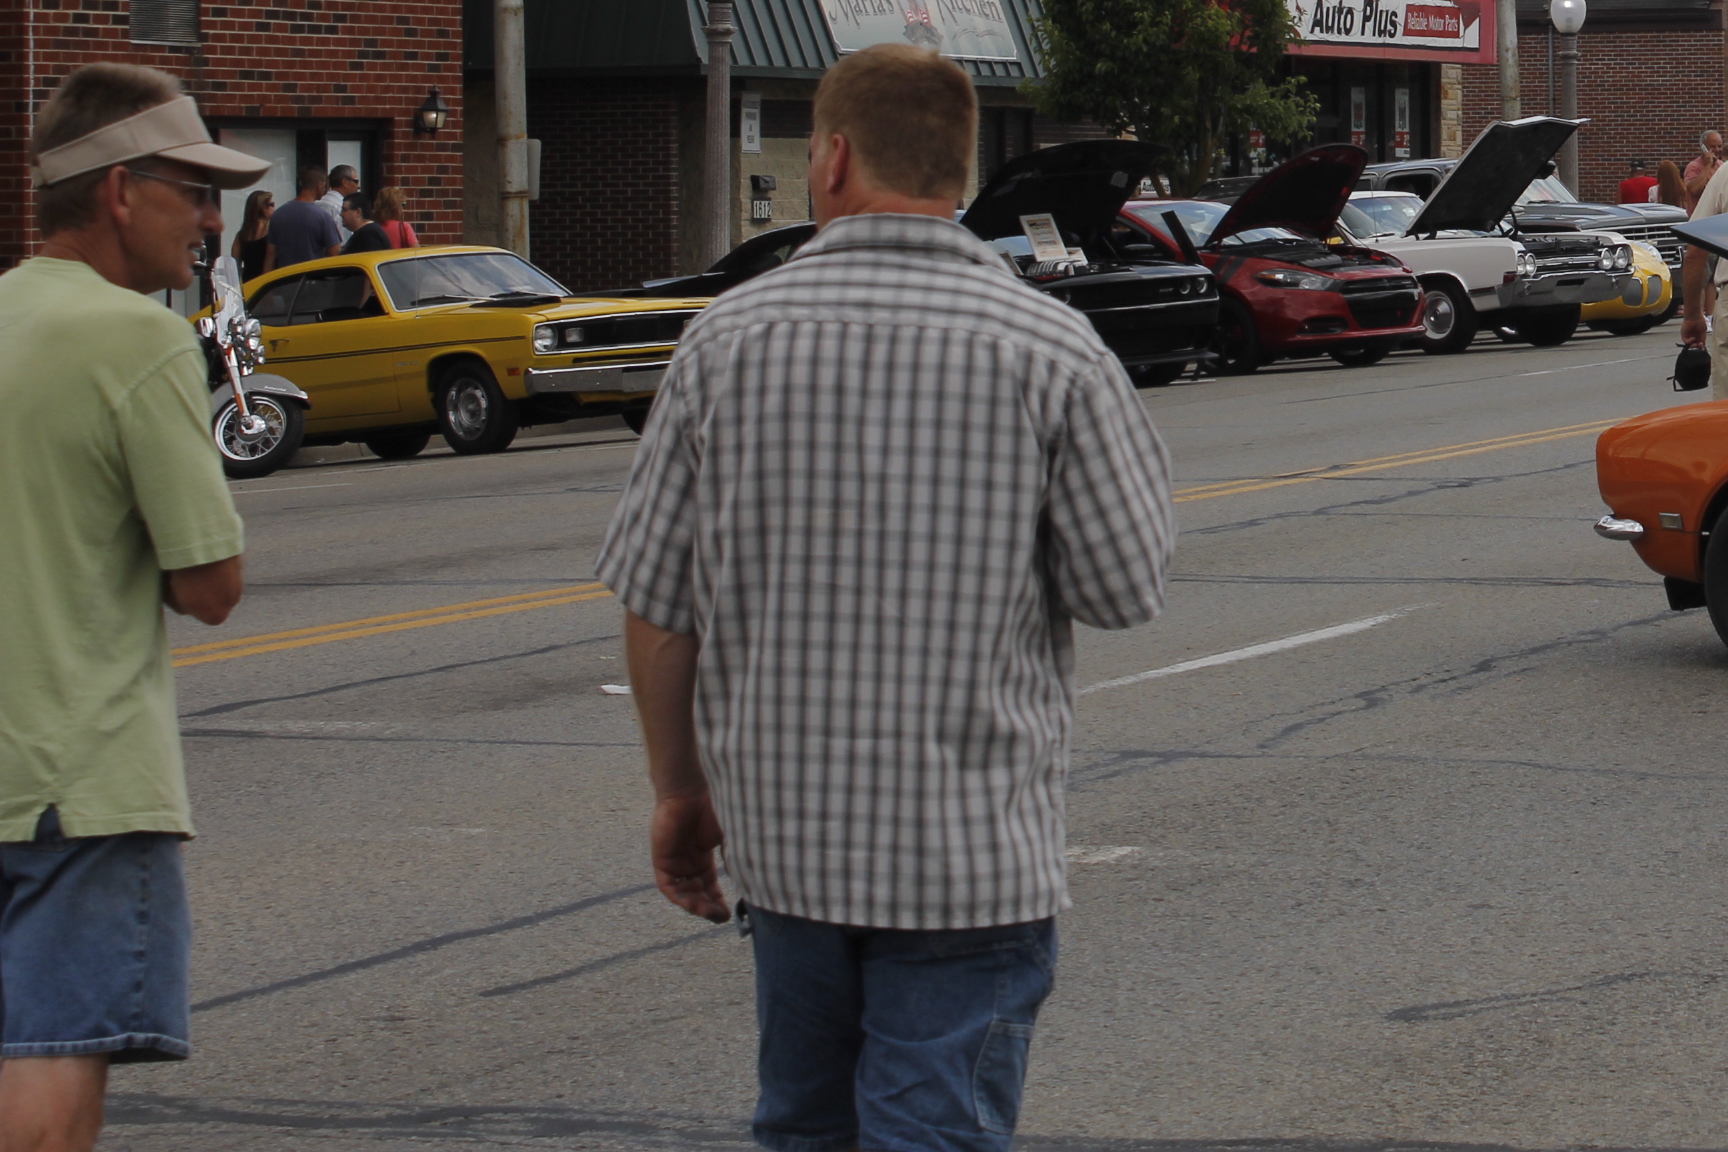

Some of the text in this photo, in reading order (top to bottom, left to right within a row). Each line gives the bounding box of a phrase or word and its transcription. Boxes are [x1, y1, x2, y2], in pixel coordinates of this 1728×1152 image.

[1407, 11, 1458, 32] Reliable Motor Parts
[754, 201, 772, 218] 1612
